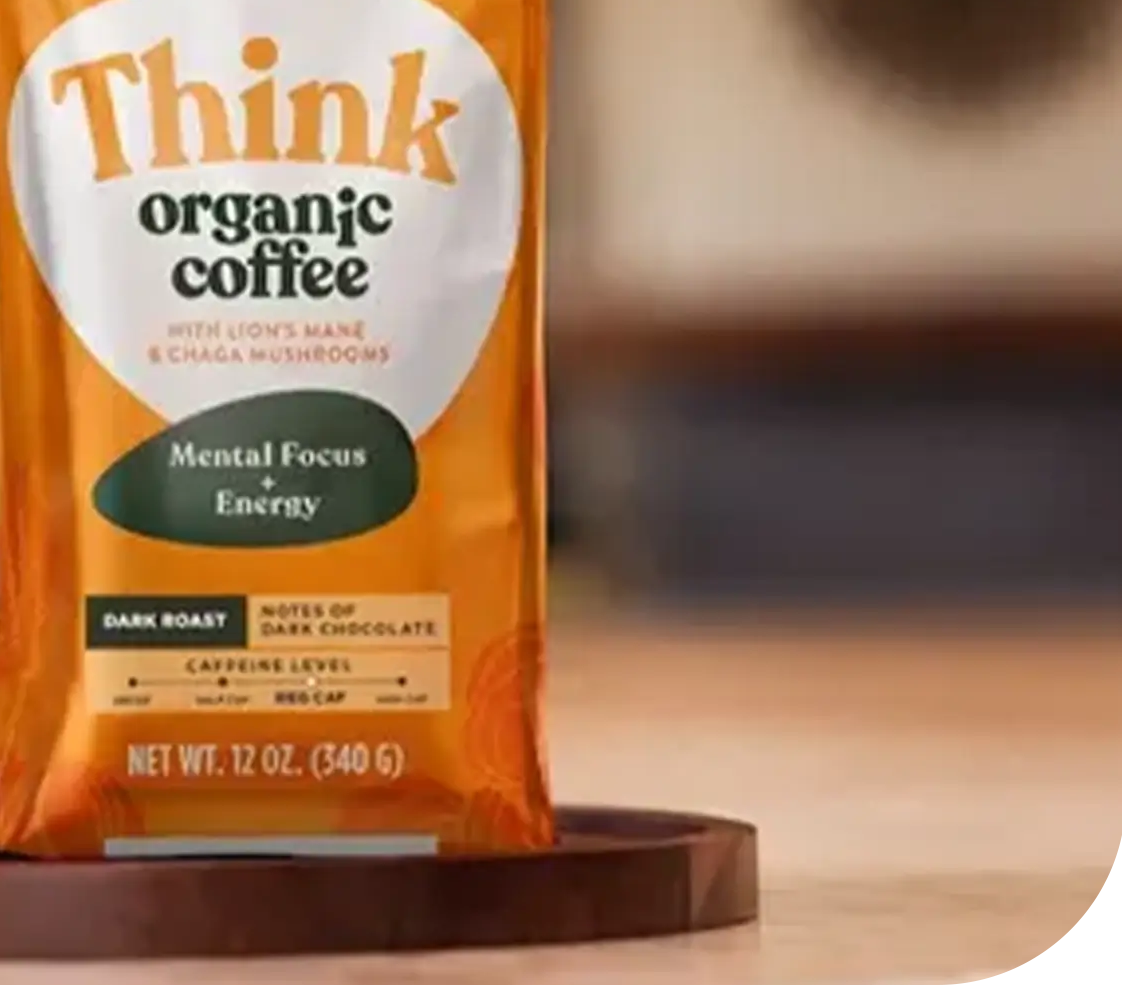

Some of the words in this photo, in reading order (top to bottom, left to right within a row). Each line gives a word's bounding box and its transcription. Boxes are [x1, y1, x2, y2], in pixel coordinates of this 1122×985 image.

[51, 36, 460, 186] Think
[138, 187, 393, 248] organic
[172, 238, 370, 299] coffee
[167, 321, 220, 339] WITH
[227, 321, 297, 340] LION'S
[304, 320, 366, 339] MANE
[166, 346, 243, 364] CHAGA
[249, 345, 390, 364] MUSHROOMS
[169, 441, 273, 467] Mental
[280, 441, 367, 467] Focus
[216, 490, 321, 521] Energy
[103, 613, 158, 629] DARK
[160, 612, 228, 629] ROAST
[260, 603, 325, 617] NOTES
[330, 603, 357, 617] OF
[260, 621, 312, 636] DARK
[320, 621, 437, 637] CHOCOLATE
[185, 658, 283, 674] CAFFEINE
[290, 658, 352, 673] LEVEL
[128, 743, 173, 777] NET
[179, 743, 225, 777] WT.
[231, 743, 257, 777] 12
[261, 743, 303, 777] OZ.
[310, 742, 370, 781] (340
[375, 742, 406, 781] G)
